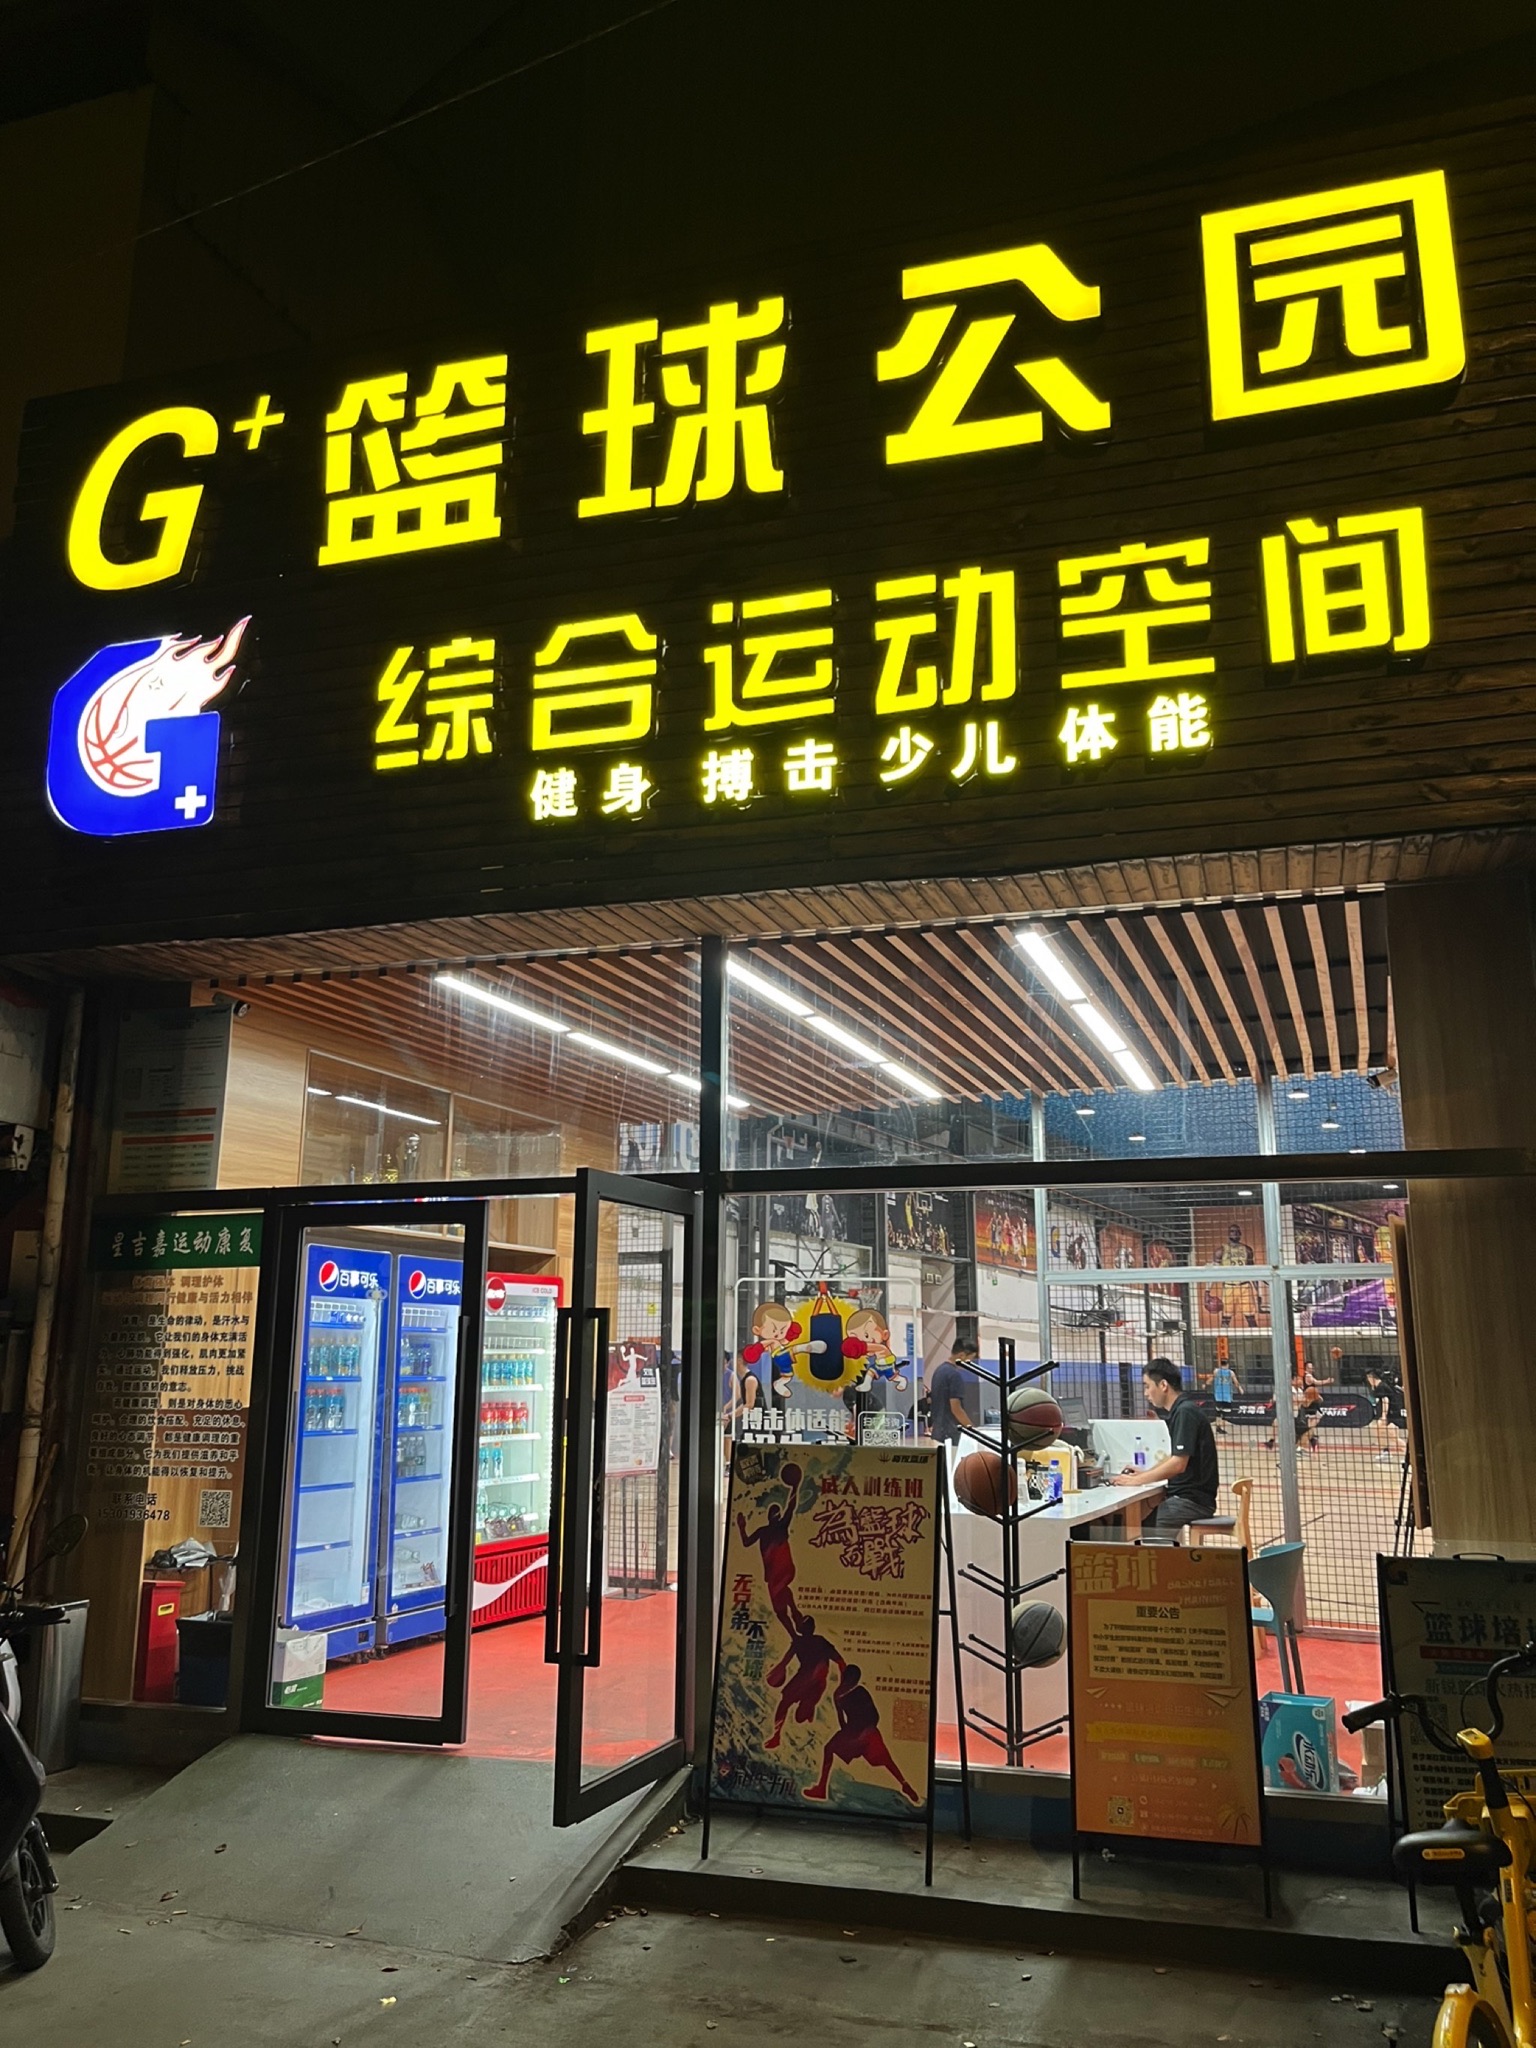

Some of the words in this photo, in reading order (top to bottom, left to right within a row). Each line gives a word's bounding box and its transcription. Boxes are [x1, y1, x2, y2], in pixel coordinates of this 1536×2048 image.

[319, 170, 1465, 565] 篮球公园
[376, 507, 1430, 769] 综合运动空间
[530, 763, 652, 820] 健身
[701, 739, 838, 803] 搏击
[880, 721, 1016, 782] 少儿
[1058, 692, 1213, 762] 体能
[340, 1269, 379, 1289] 百事可乐
[427, 1278, 461, 1295] 百事可乐
[742, 1407, 850, 1432] 搏击体适能
[821, 1476, 924, 1498] 成人训练班
[113, 1493, 158, 1505] 联系电话
[731, 1573, 752, 1630] 无兄弟
[1136, 1606, 1180, 1619] 重要公告
